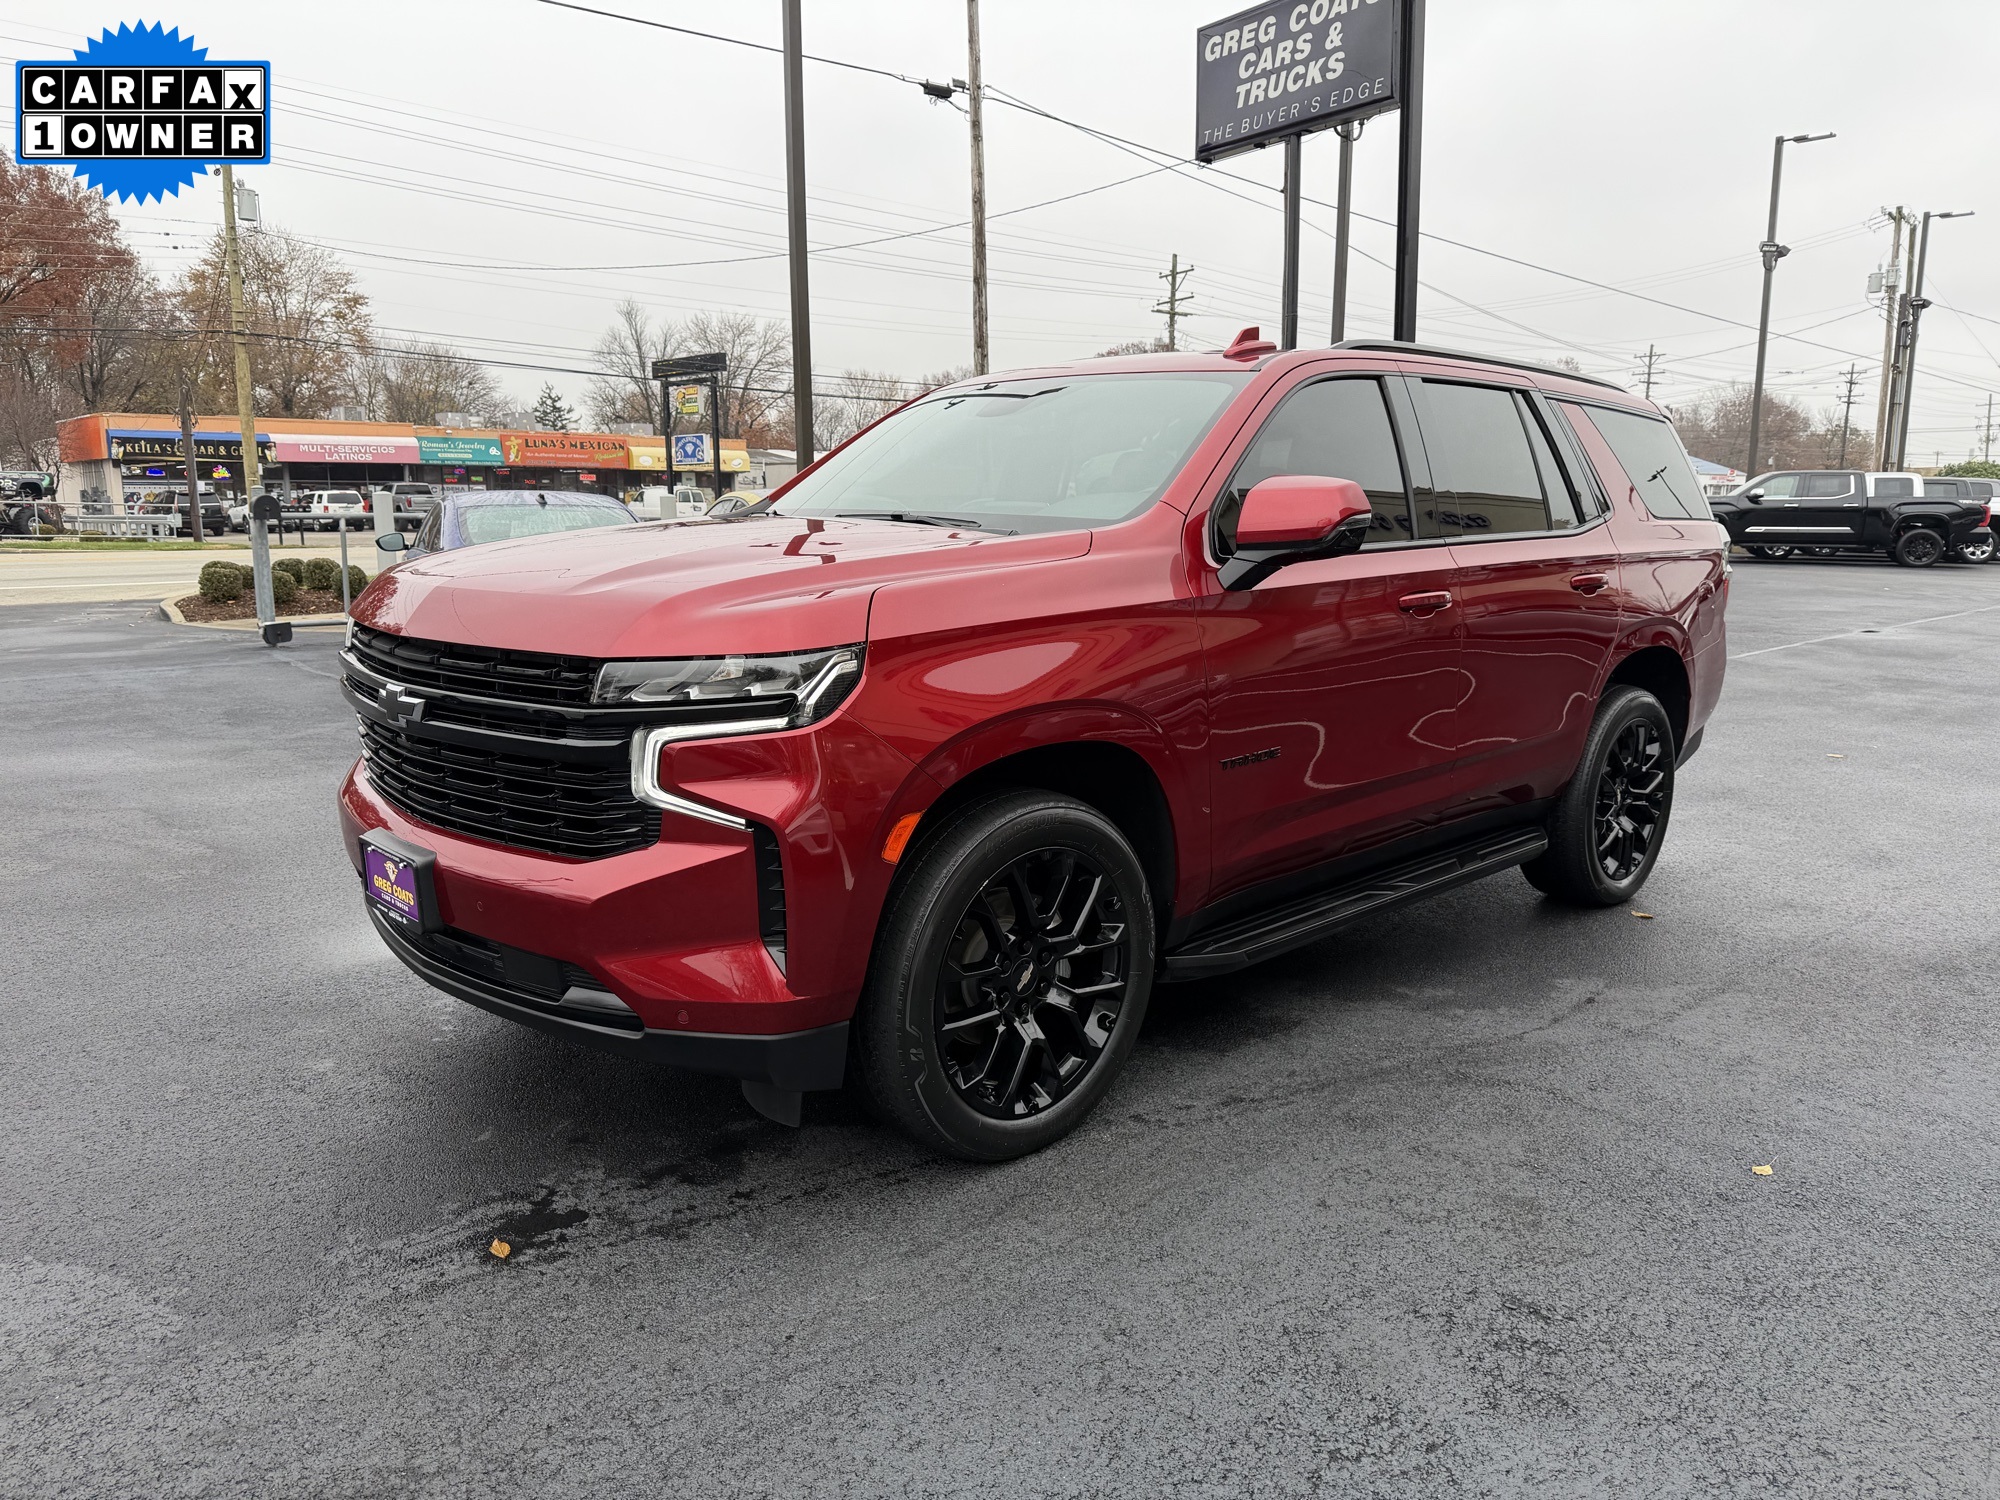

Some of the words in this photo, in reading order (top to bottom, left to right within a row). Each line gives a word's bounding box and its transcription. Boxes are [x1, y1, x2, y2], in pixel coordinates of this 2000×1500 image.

[1204, 15, 1277, 62] GREG
[1289, 0, 1379, 32] COA
[1238, 32, 1313, 79] CARS
[1324, 21, 1343, 50] &
[1235, 51, 1346, 109] TRUCKS
[1204, 122, 1234, 145] THE
[1241, 97, 1321, 134] BUYER'S
[1329, 77, 1385, 108] EDGE
[126, 440, 172, 454] KEILA'S
[218, 445, 227, 455] &
[300, 444, 395, 454] MULTI-SERVICIOS
[420, 440, 454, 448] Roman's
[455, 441, 486, 451] Jewelry
[524, 438, 566, 449] LUNA'S
[569, 440, 625, 451] MEXICAN
[325, 453, 373, 461] LATINOS
[373, 874, 392, 894] GREG
[392, 884, 415, 906] COATS
